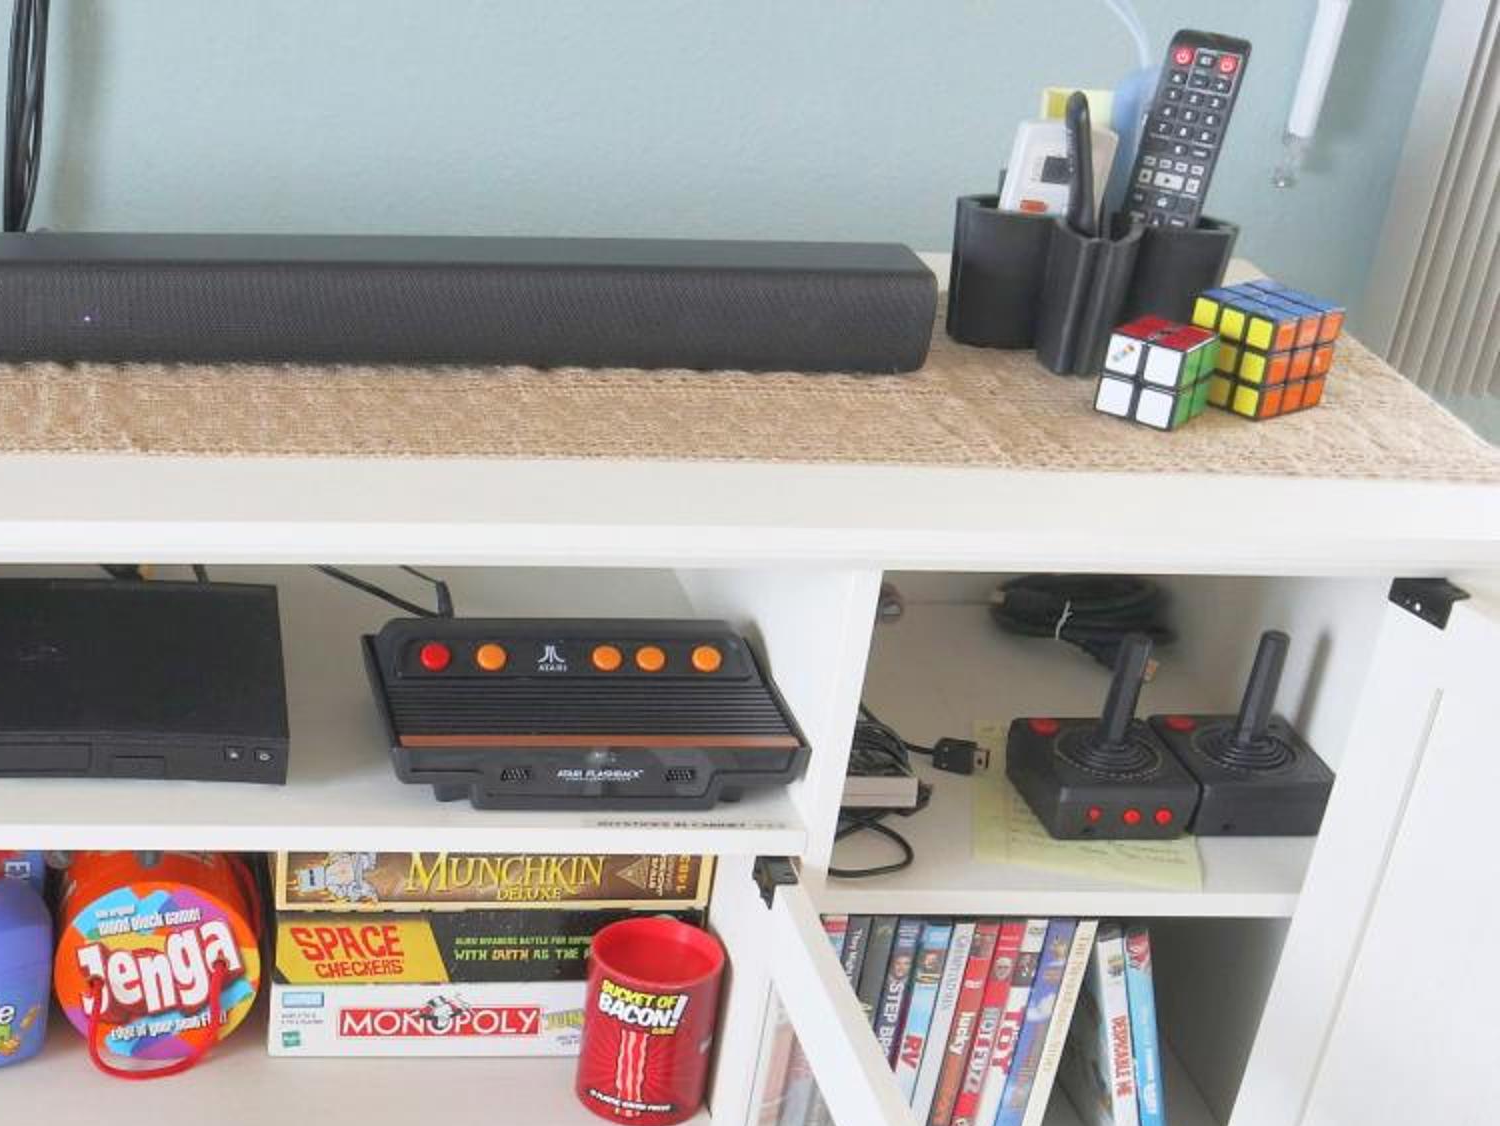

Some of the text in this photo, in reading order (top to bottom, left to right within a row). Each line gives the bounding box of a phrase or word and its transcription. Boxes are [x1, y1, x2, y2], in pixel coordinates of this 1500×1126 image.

[403, 854, 605, 894] MUNCHKIN
[497, 885, 561, 900] DELUXE
[291, 925, 405, 962] SPACE
[77, 920, 242, 1017] Jenga
[315, 959, 405, 979] CHECKERS
[601, 979, 679, 1008] BUCKET OF
[341, 1008, 539, 1035] MONOPOLY
[598, 993, 688, 1028] BACON!
